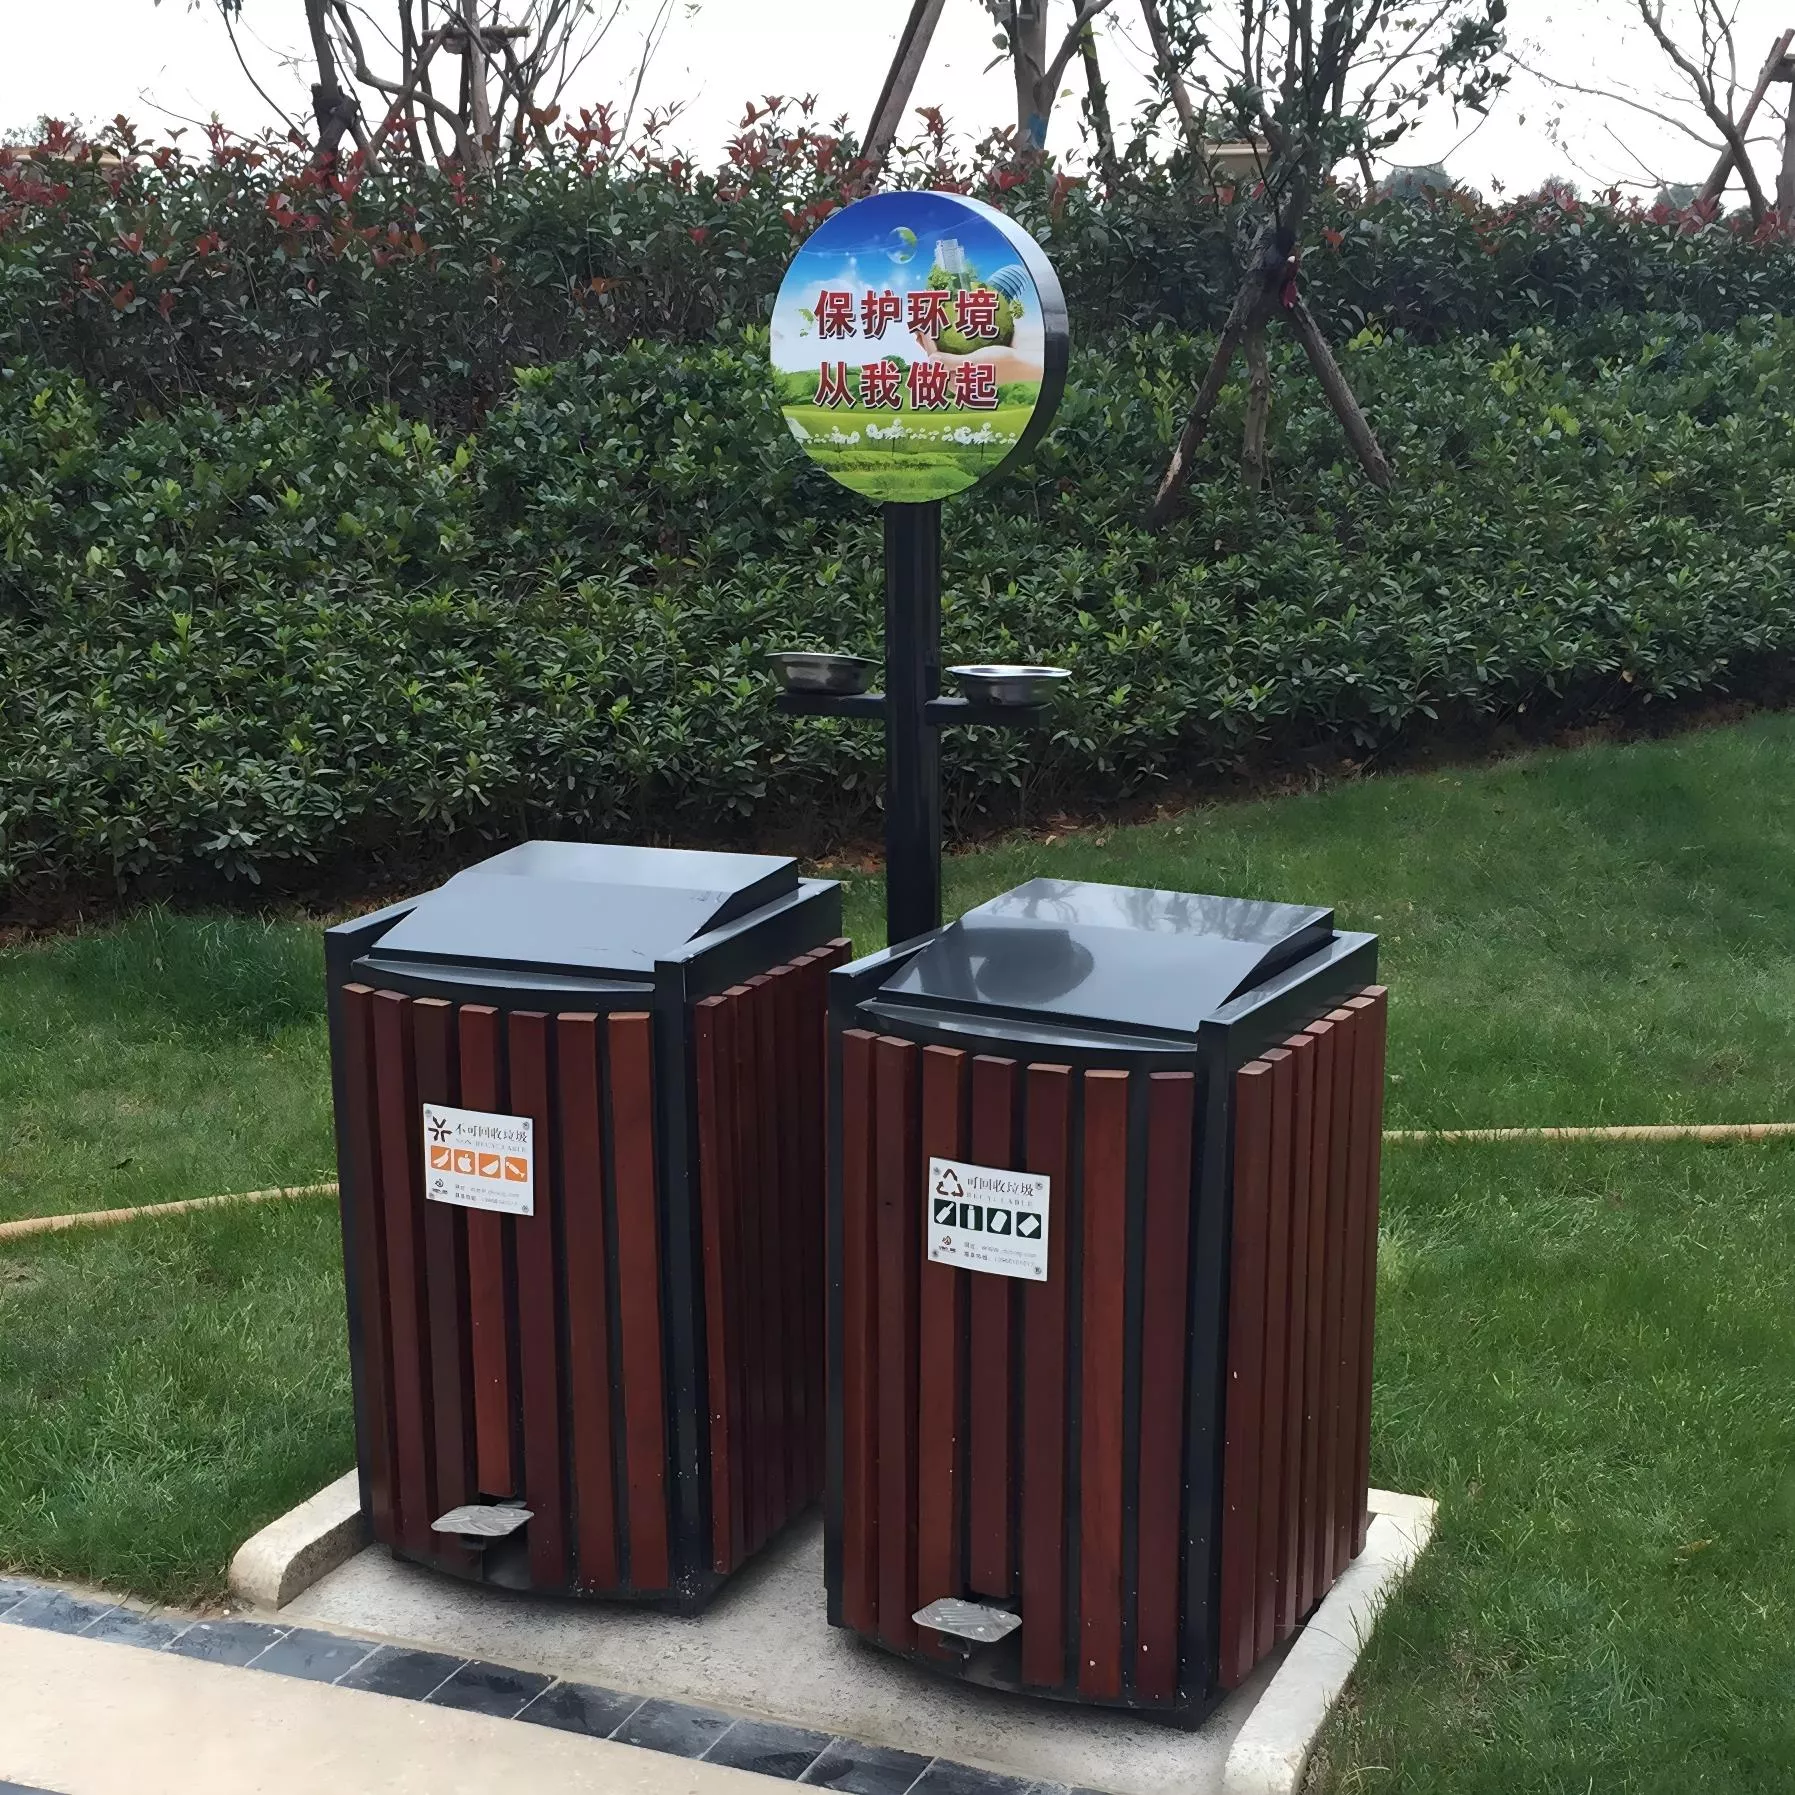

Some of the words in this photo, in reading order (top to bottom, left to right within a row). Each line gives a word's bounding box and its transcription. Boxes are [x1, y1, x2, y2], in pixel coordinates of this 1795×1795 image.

[814, 289, 1000, 339] 保护环境
[812, 361, 1000, 411] 从我做起
[967, 1176, 1035, 1197] 可回收垃圾
